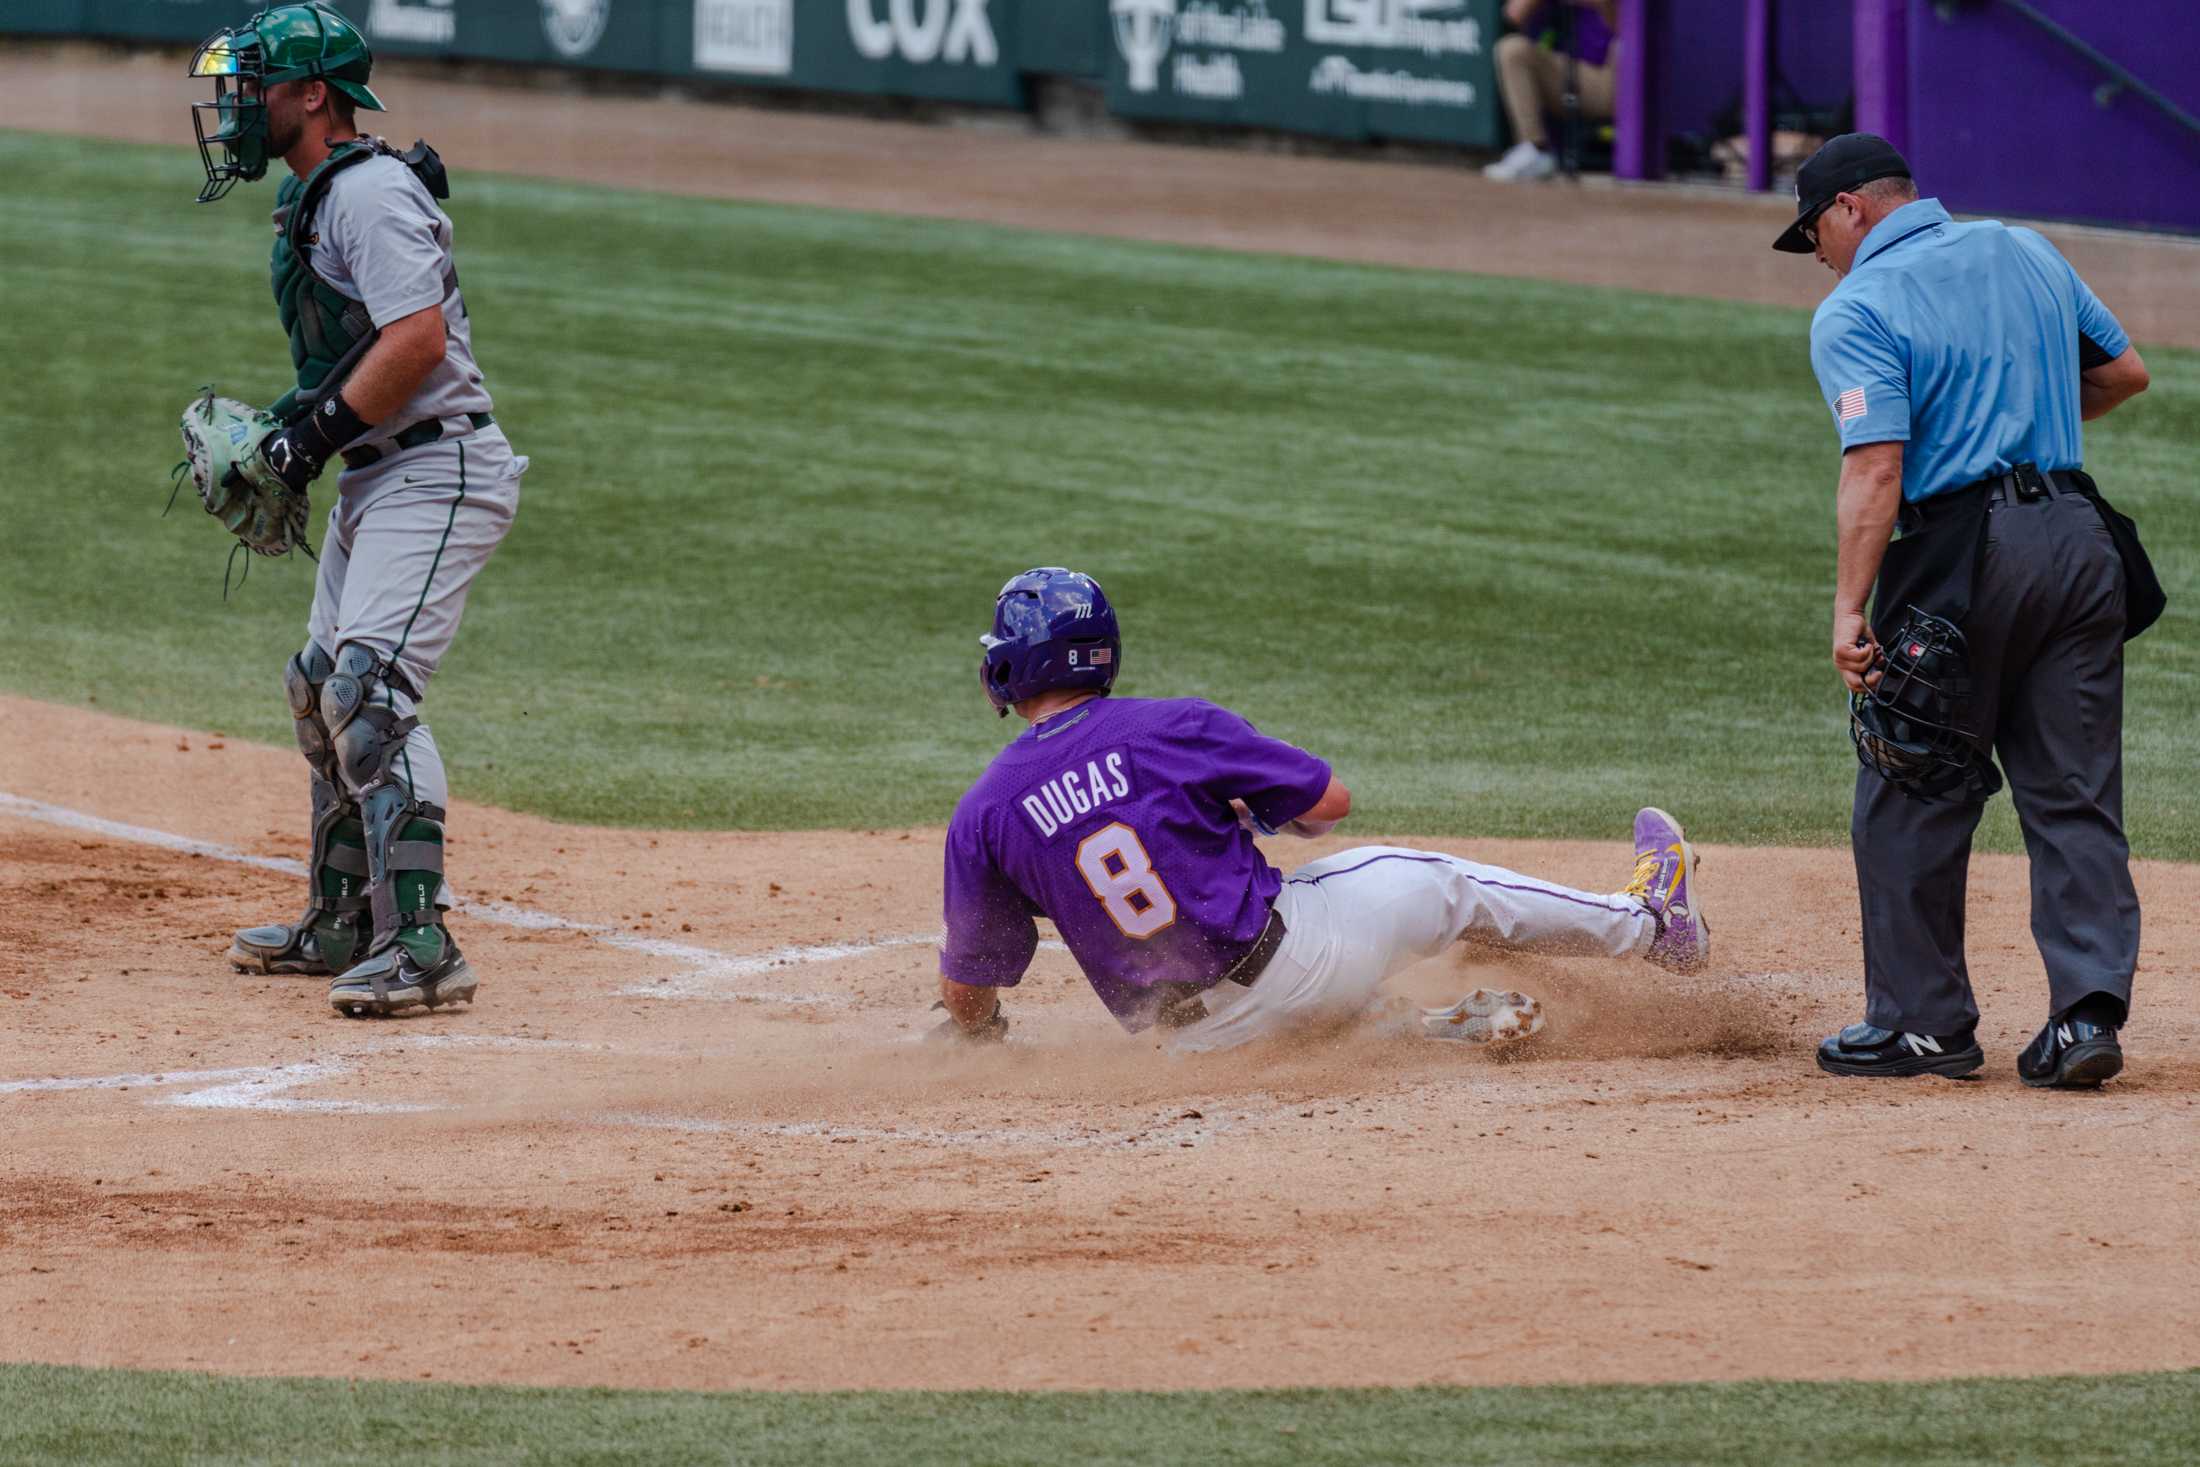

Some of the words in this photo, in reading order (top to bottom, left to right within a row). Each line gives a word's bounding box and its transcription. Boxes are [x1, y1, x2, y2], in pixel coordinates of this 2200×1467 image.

[1068, 649, 1078, 665] 8
[1022, 752, 1129, 838] DUGAS
[1075, 821, 1177, 940] 8
